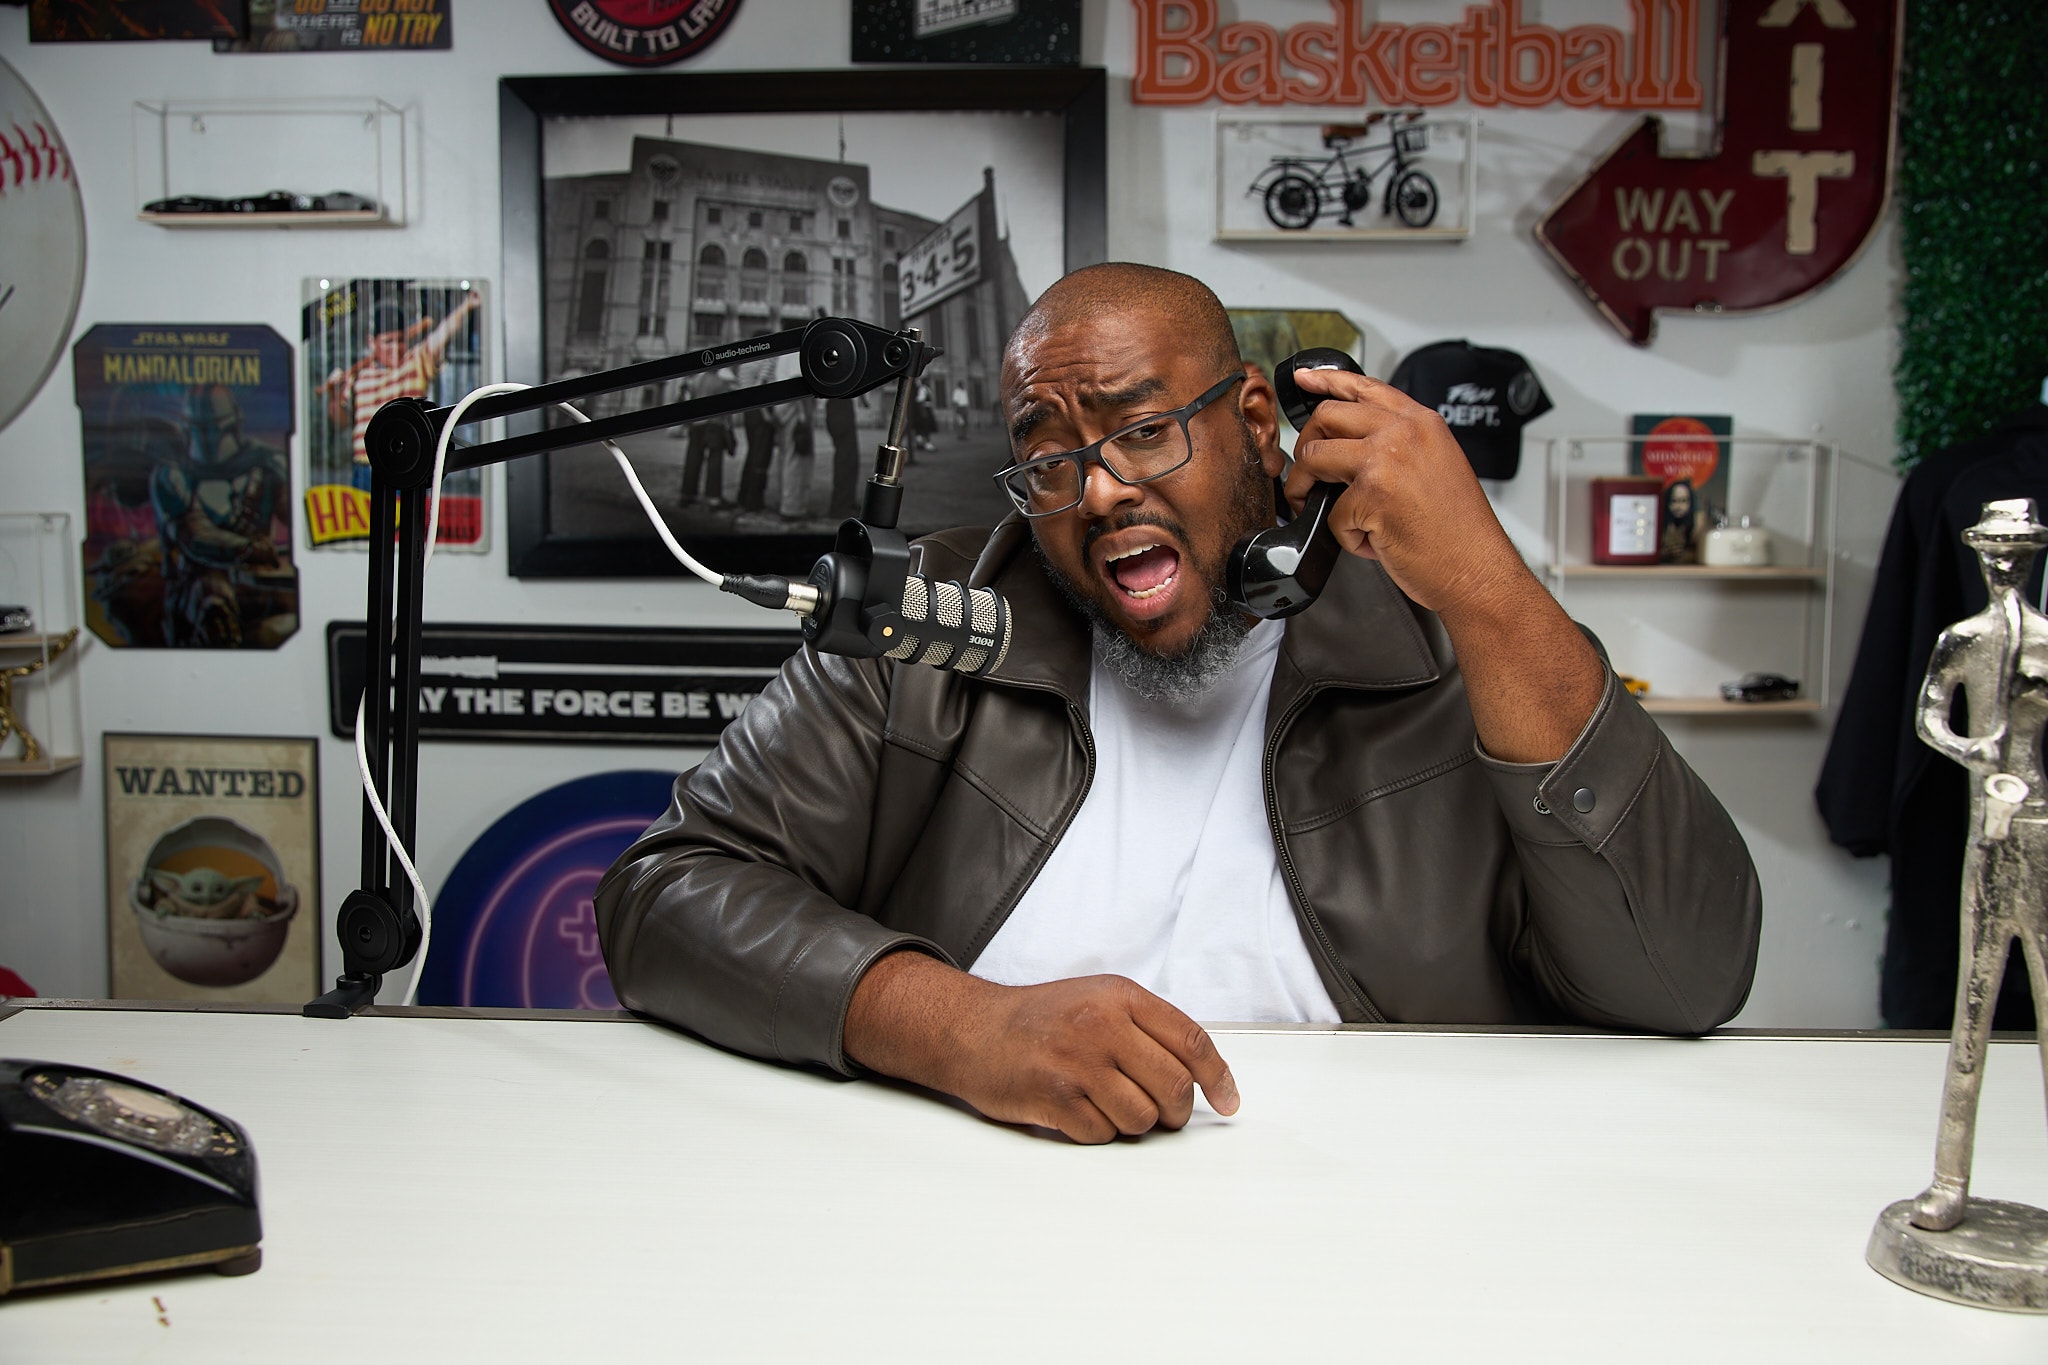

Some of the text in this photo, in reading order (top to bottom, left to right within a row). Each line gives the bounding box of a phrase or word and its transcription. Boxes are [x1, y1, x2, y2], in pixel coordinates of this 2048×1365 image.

[289, 14, 360, 30] THERE
[361, 13, 399, 46] NO
[399, 13, 443, 46] TRY
[570, 1, 640, 53] BUILT
[641, 25, 681, 53] TO
[1132, 0, 1703, 110] Basketball
[1614, 187, 1736, 234] WAY
[1612, 239, 1730, 282] OUT
[131, 331, 231, 346] STAR WARS
[714, 342, 771, 360] audio-technica
[103, 353, 261, 386] MANDALORIAN
[1438, 404, 1500, 427] DEPT.
[968, 634, 996, 648] RØDE
[452, 687, 525, 715] THE
[532, 689, 656, 717] FORCE
[661, 691, 711, 719] BE
[115, 765, 306, 799] WANTED
